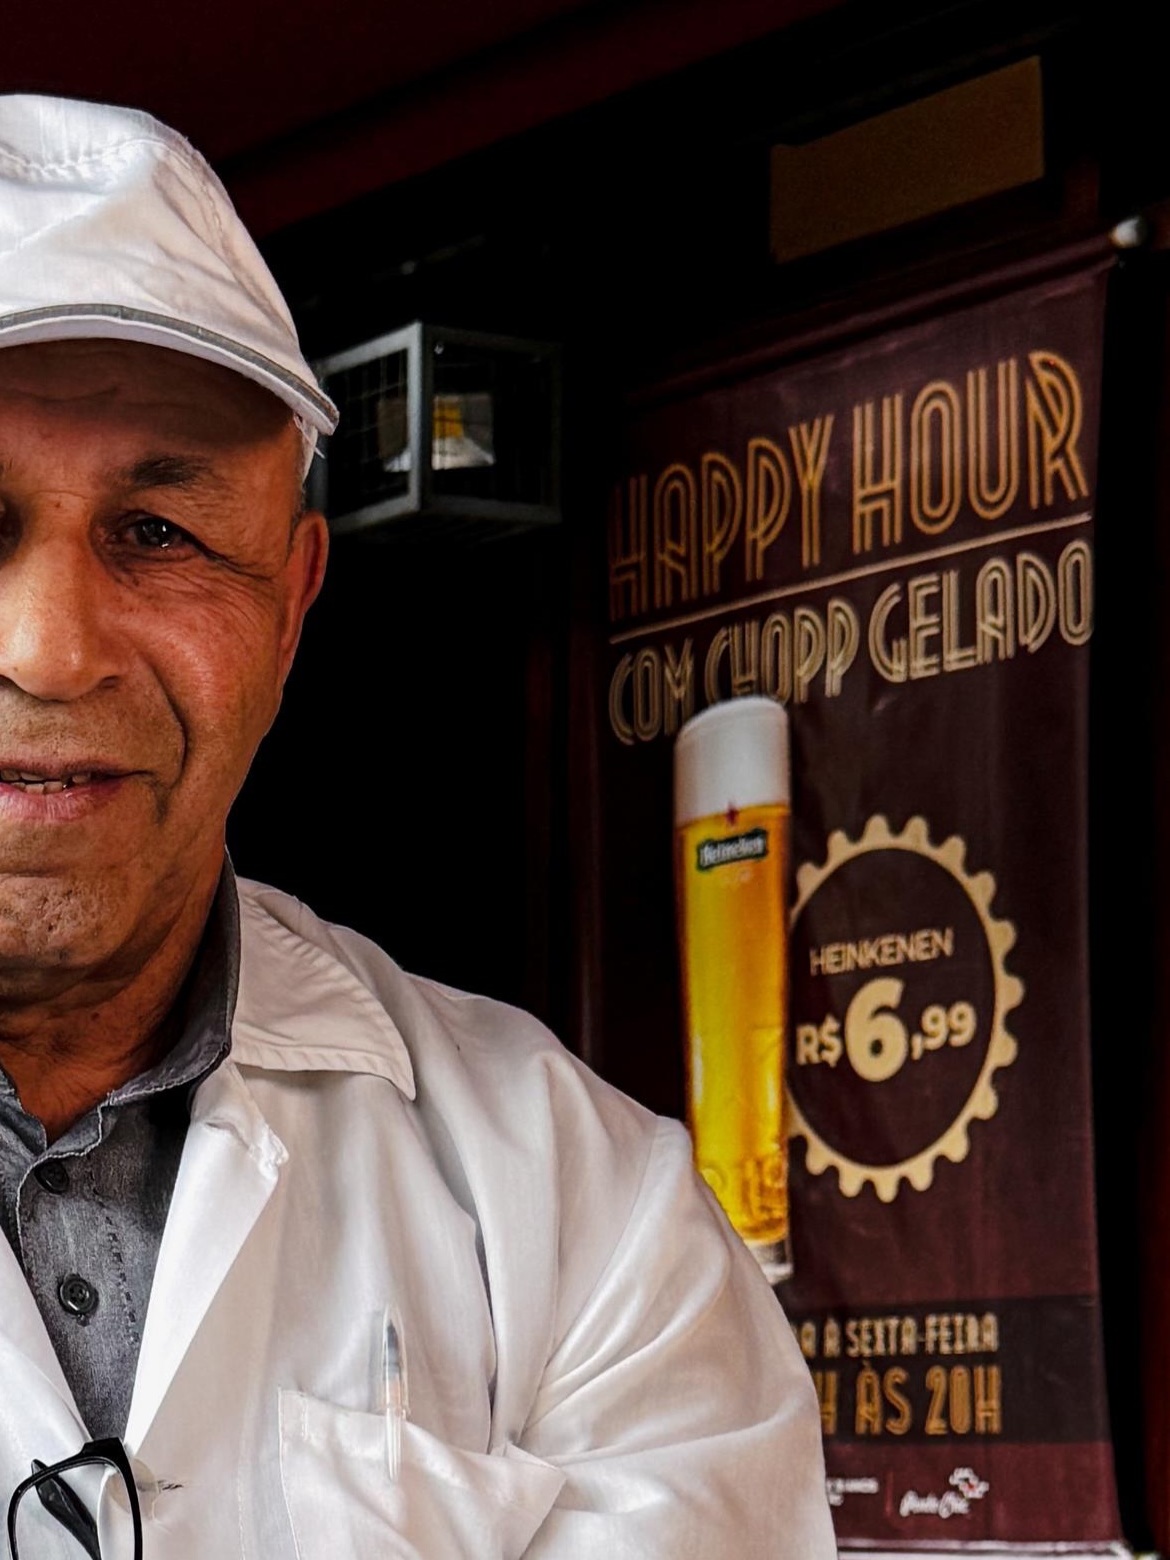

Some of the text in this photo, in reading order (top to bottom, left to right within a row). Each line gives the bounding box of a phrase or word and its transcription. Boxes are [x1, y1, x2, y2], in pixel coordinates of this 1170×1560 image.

[609, 350, 1089, 621] HAPPY HOUR
[608, 540, 1094, 746] COM CHOPP GELADO
[809, 927, 955, 977] HEINKENEN
[925, 1364, 1003, 1437] 20H
